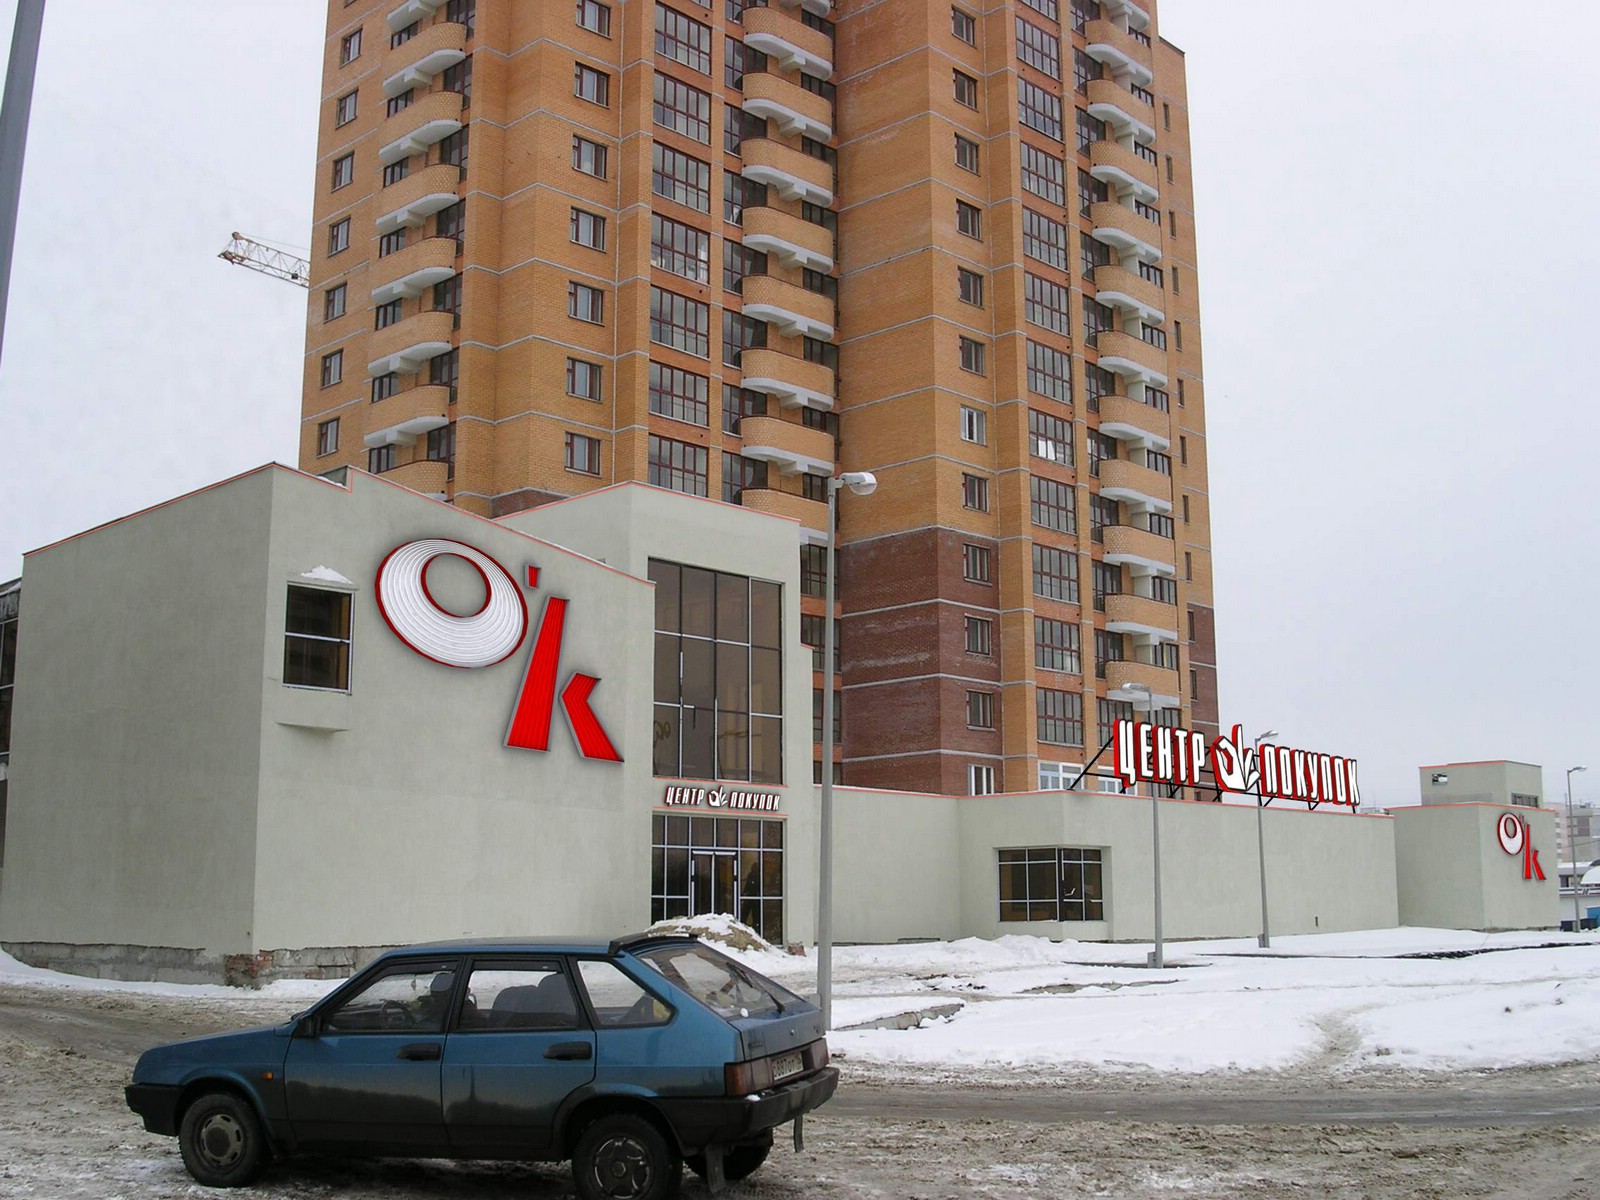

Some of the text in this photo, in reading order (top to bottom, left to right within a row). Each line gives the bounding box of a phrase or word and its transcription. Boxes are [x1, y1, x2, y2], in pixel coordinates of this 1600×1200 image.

[1113, 718, 1360, 806] ЦЕНТР ПОКУПОК
[665, 786, 781, 811] ЦЕНТР ПОКУПОК
